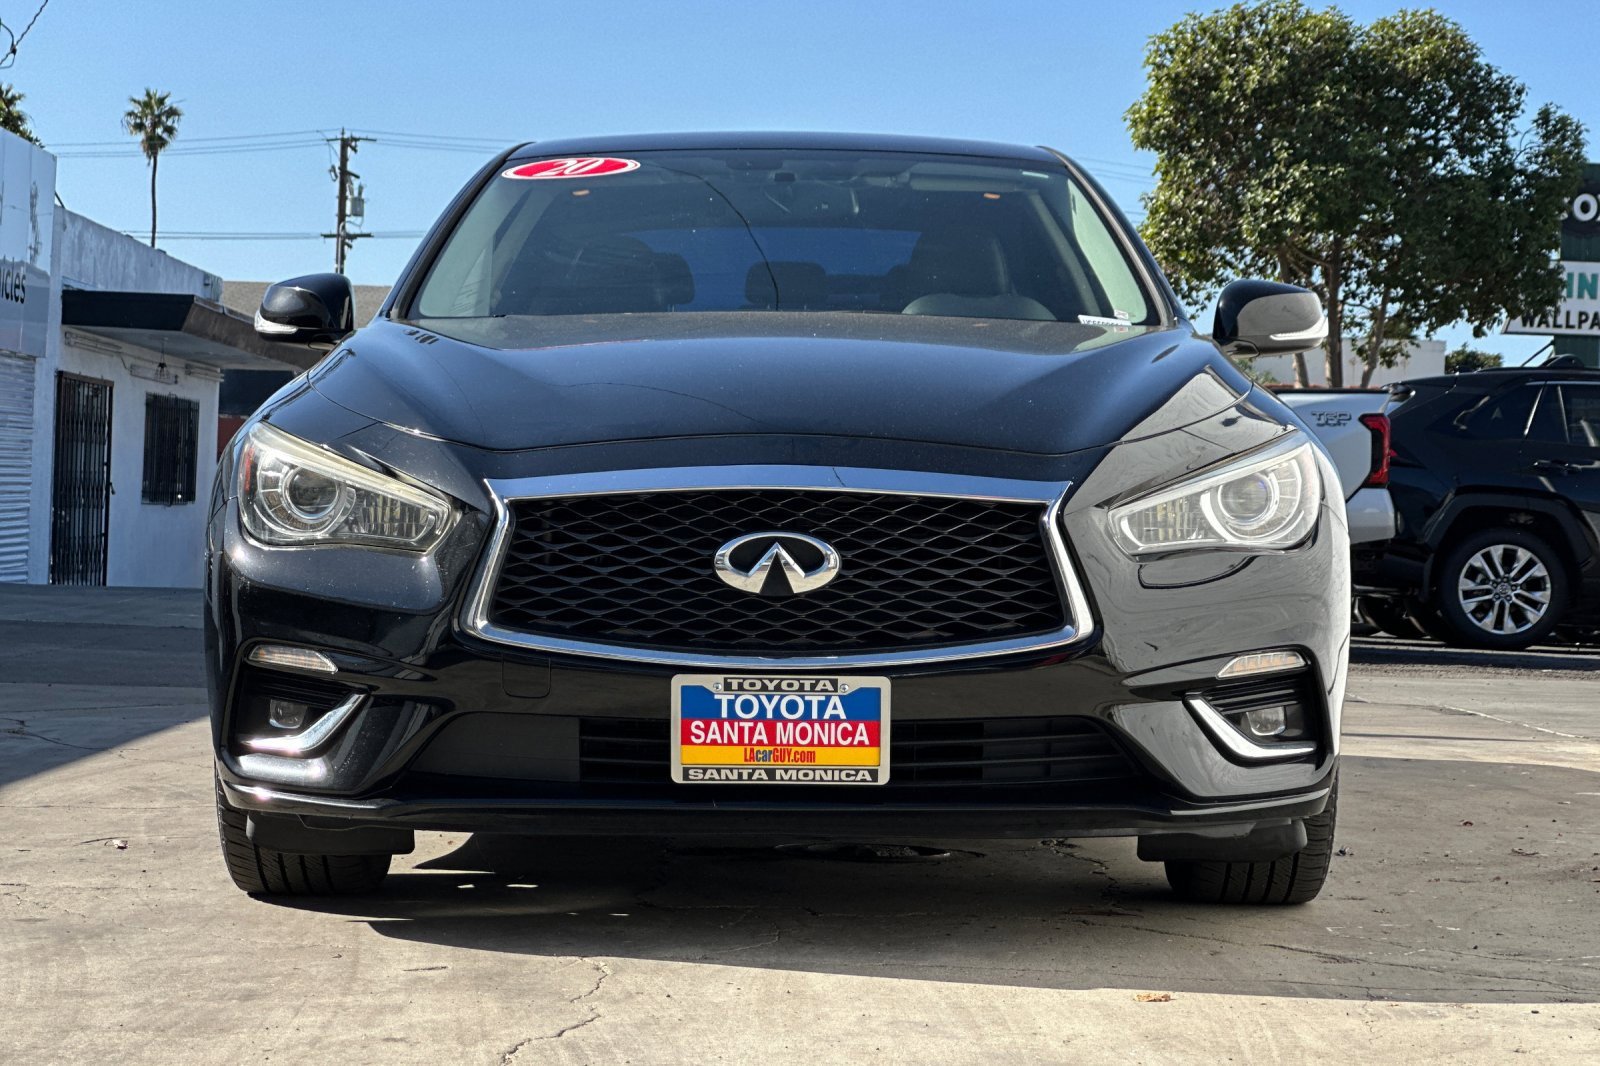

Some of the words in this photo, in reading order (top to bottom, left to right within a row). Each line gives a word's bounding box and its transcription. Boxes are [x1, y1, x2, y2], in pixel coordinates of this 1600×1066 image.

[531, 157, 605, 177] 20
[0, 254, 26, 304] icles
[727, 678, 835, 692] TOYOTA
[714, 694, 847, 720] TOYOTA
[690, 720, 769, 745] SANTA
[776, 721, 870, 746] MONICA
[743, 747, 816, 764] LAcarGUY.com
[688, 768, 769, 781] SANTA
[775, 769, 873, 782] MONICA
